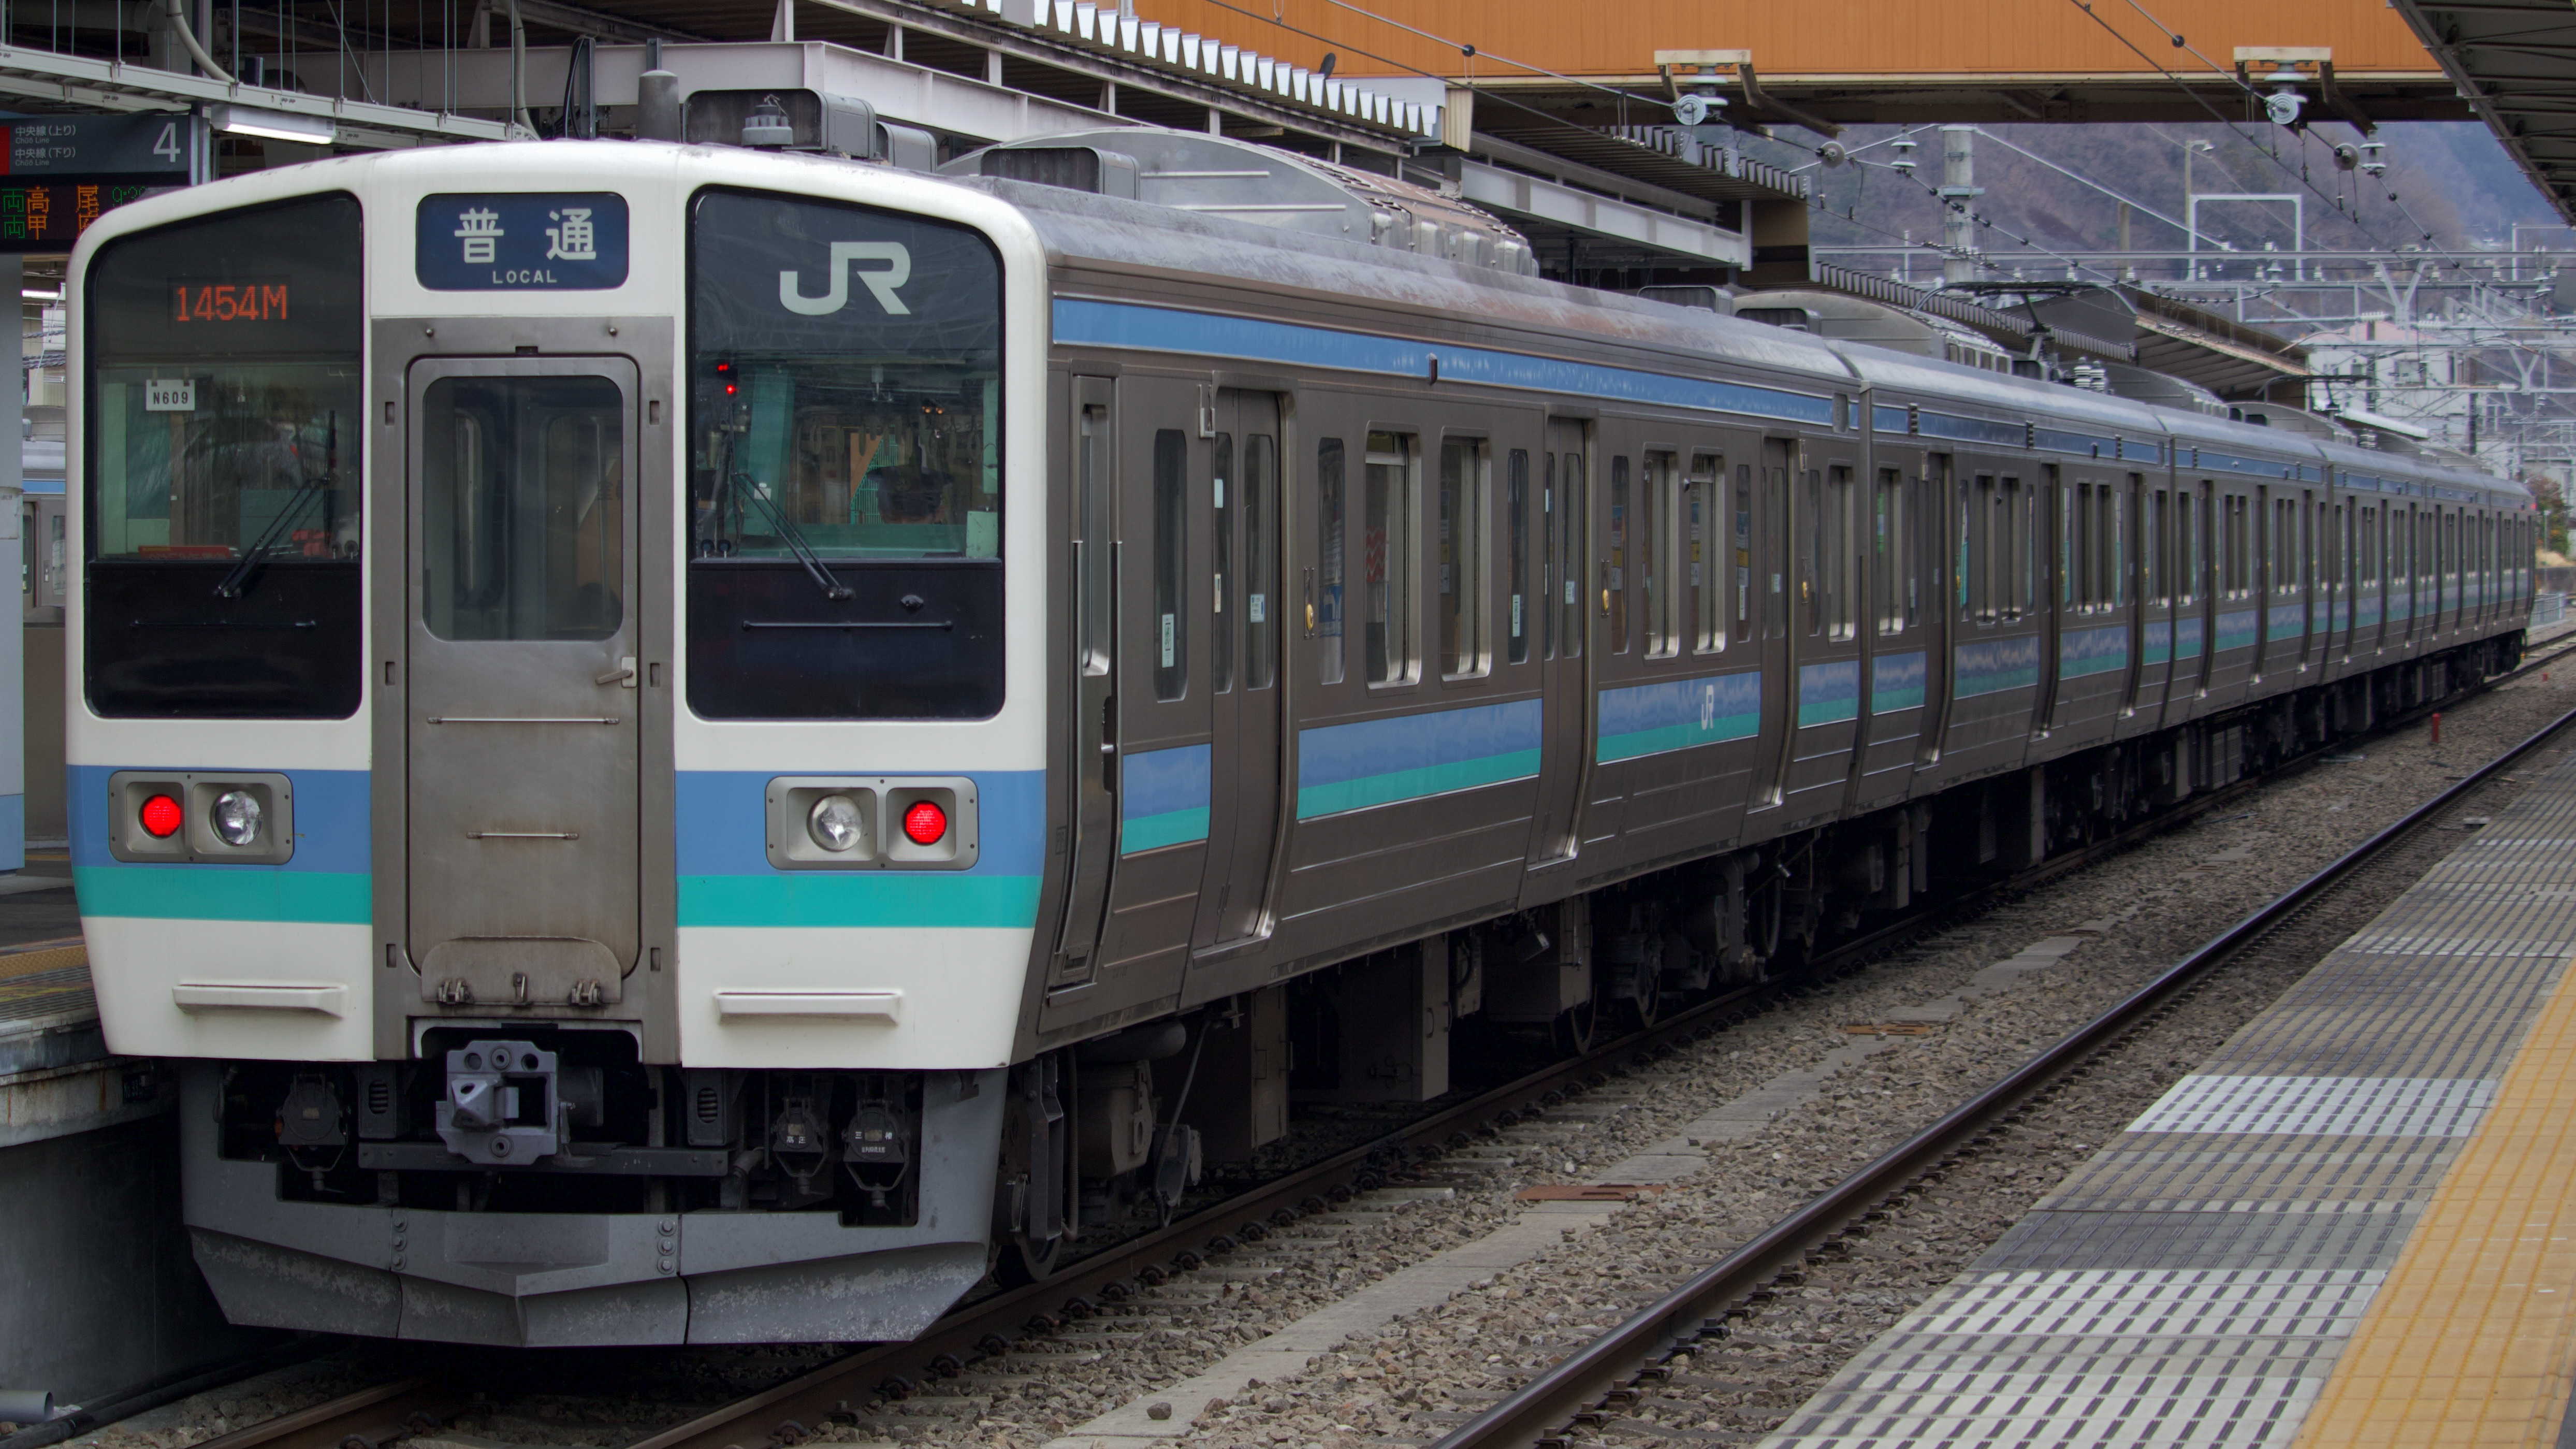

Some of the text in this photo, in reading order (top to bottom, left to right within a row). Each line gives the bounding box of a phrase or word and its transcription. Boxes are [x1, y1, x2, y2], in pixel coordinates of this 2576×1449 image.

[16, 124, 76, 137] 中央線(上り)
[153, 122, 181, 163] 4
[16, 147, 76, 159] 中央線(下り)
[492, 270, 557, 284] LOCAL
[780, 241, 910, 315] JR
[176, 284, 288, 321] 1454M
[153, 391, 189, 405] N609
[1701, 685, 1714, 731] JR
